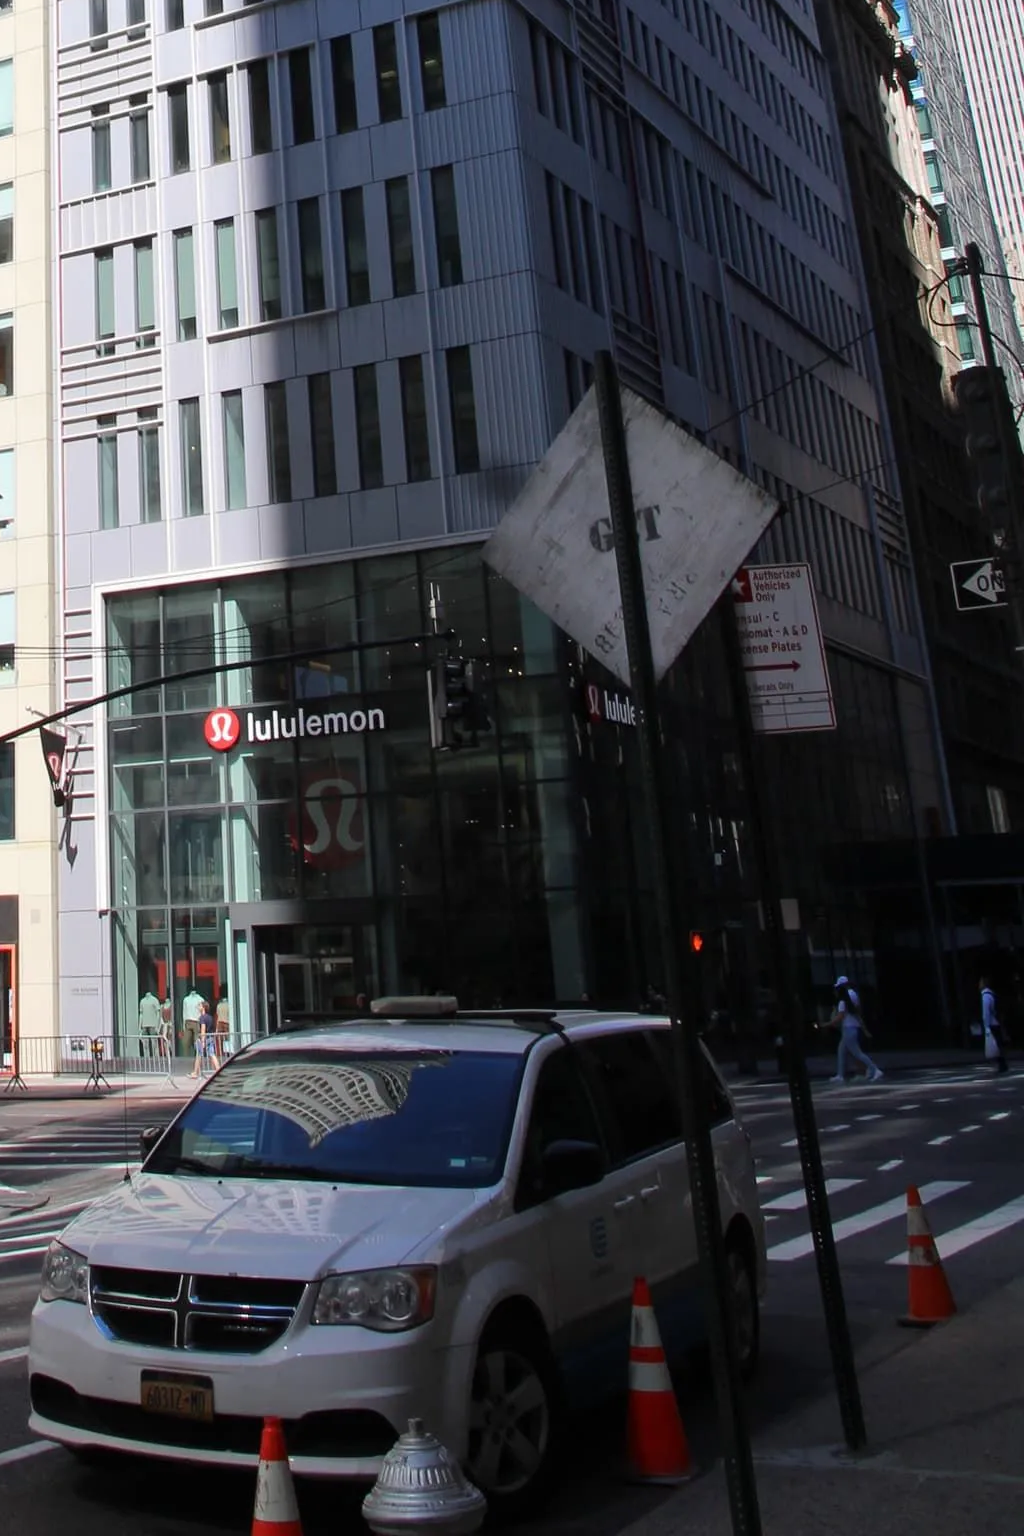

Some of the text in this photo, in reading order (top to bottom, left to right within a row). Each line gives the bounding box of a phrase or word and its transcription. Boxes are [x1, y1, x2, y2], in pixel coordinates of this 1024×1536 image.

[752, 569, 801, 582] Authorized
[754, 581, 791, 592] Vehicles
[755, 592, 776, 603] Only
[773, 611, 780, 622] C
[782, 626, 790, 637] A
[801, 624, 808, 636] D
[772, 640, 803, 653] Plates
[247, 707, 385, 743] lululemon
